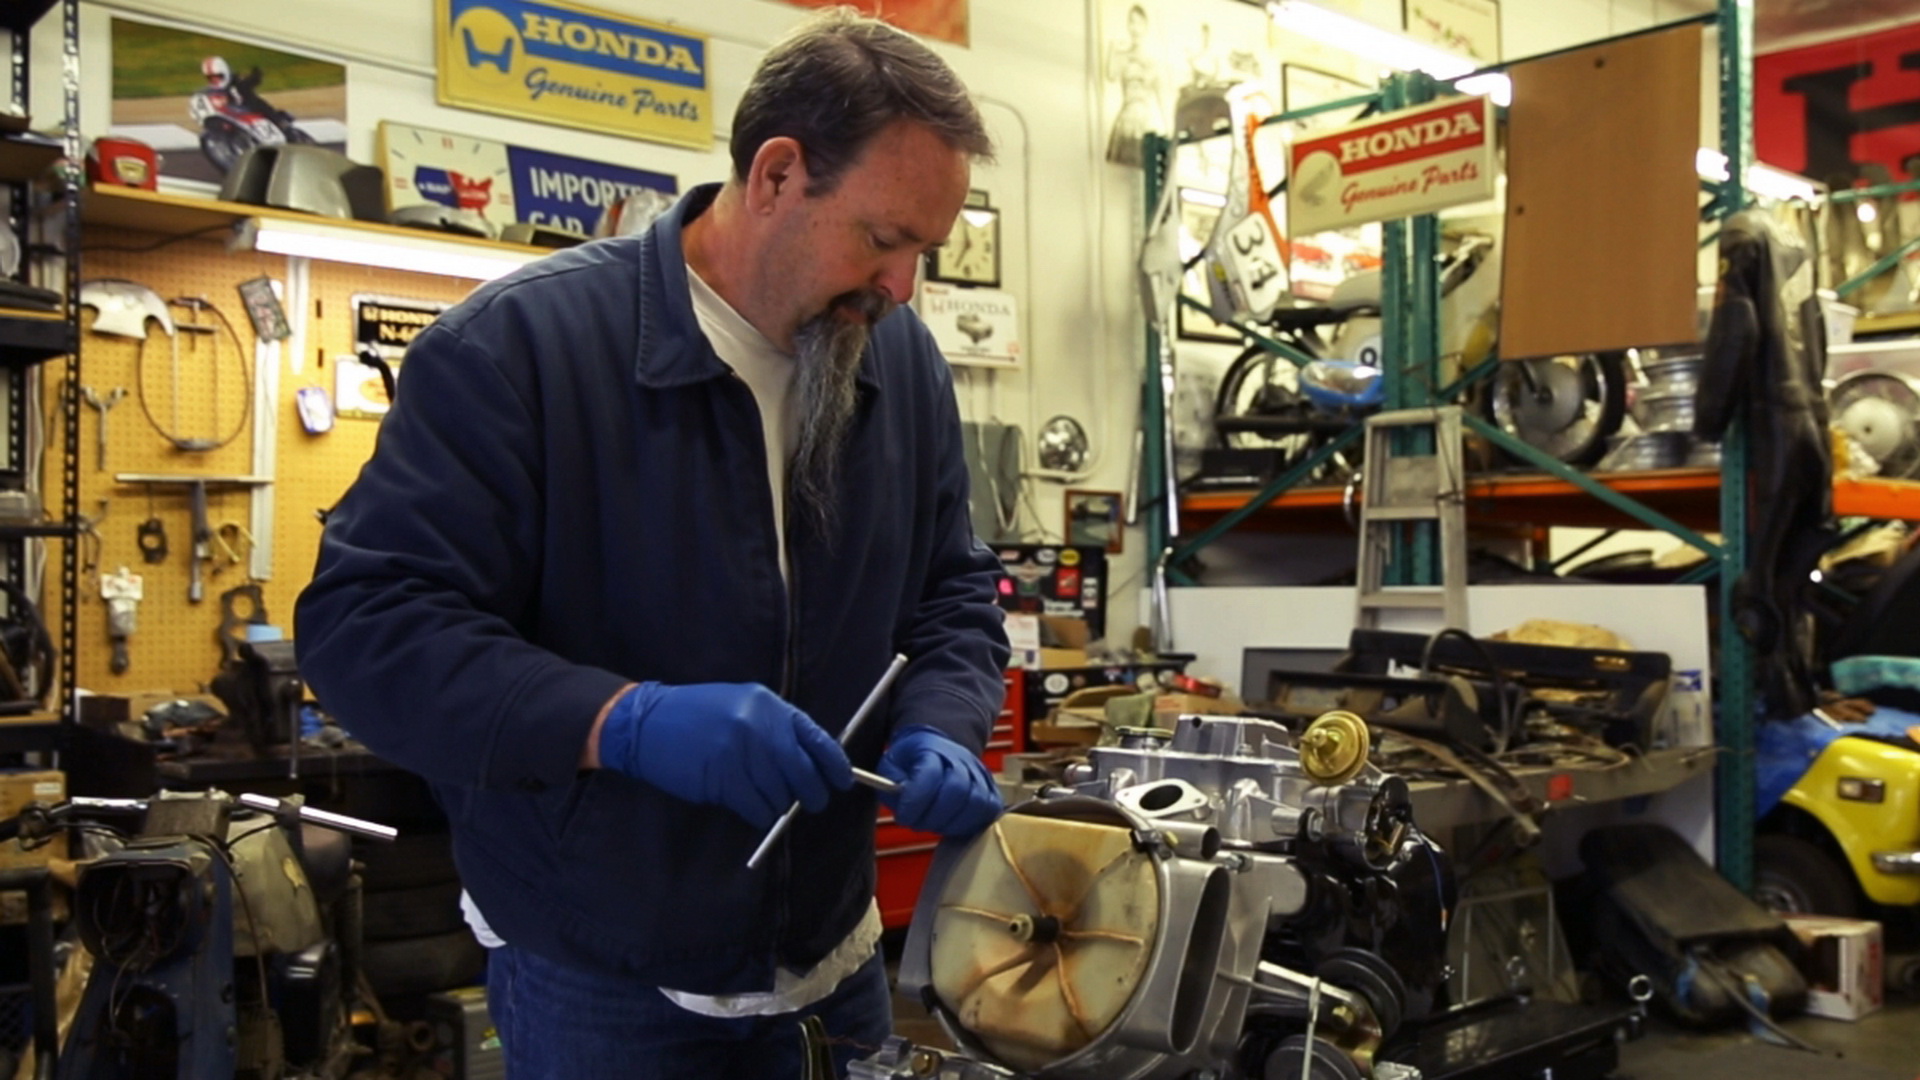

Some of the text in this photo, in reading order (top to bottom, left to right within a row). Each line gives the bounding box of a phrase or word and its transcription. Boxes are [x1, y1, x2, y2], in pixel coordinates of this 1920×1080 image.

[522, 12, 701, 74] HONDA
[523, 67, 699, 122] Genuine Parts
[1338, 112, 1481, 163] HONDA
[529, 167, 657, 209] IMPORT
[1340, 160, 1479, 214] Genuine Parts
[380, 308, 438, 325] HOND
[947, 299, 1011, 316] HONDA
